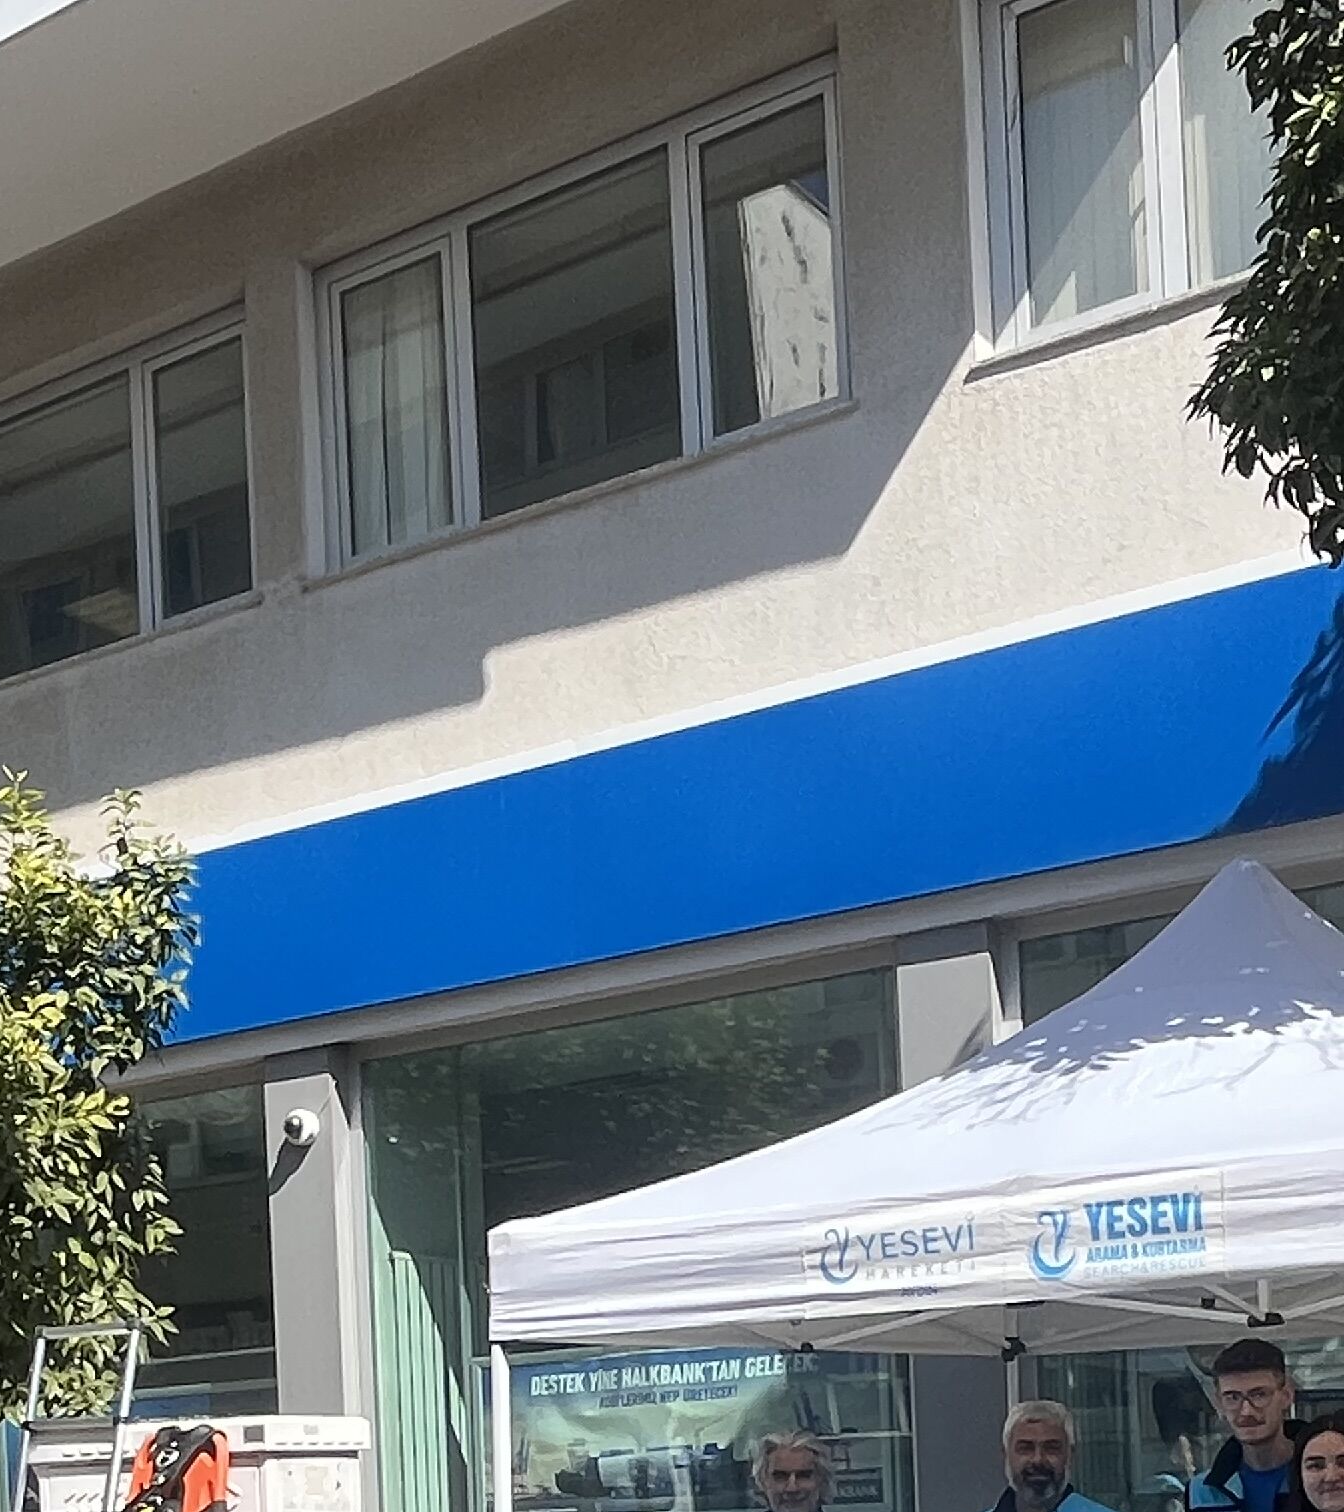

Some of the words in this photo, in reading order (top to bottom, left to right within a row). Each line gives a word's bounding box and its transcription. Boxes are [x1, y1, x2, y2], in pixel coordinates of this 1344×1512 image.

[856, 1210, 976, 1262] YESEVİ
[1083, 1184, 1205, 1242] YESEVİ
[529, 1371, 586, 1396] DESTEK
[620, 1357, 741, 1389] HALKBANK'TAN
